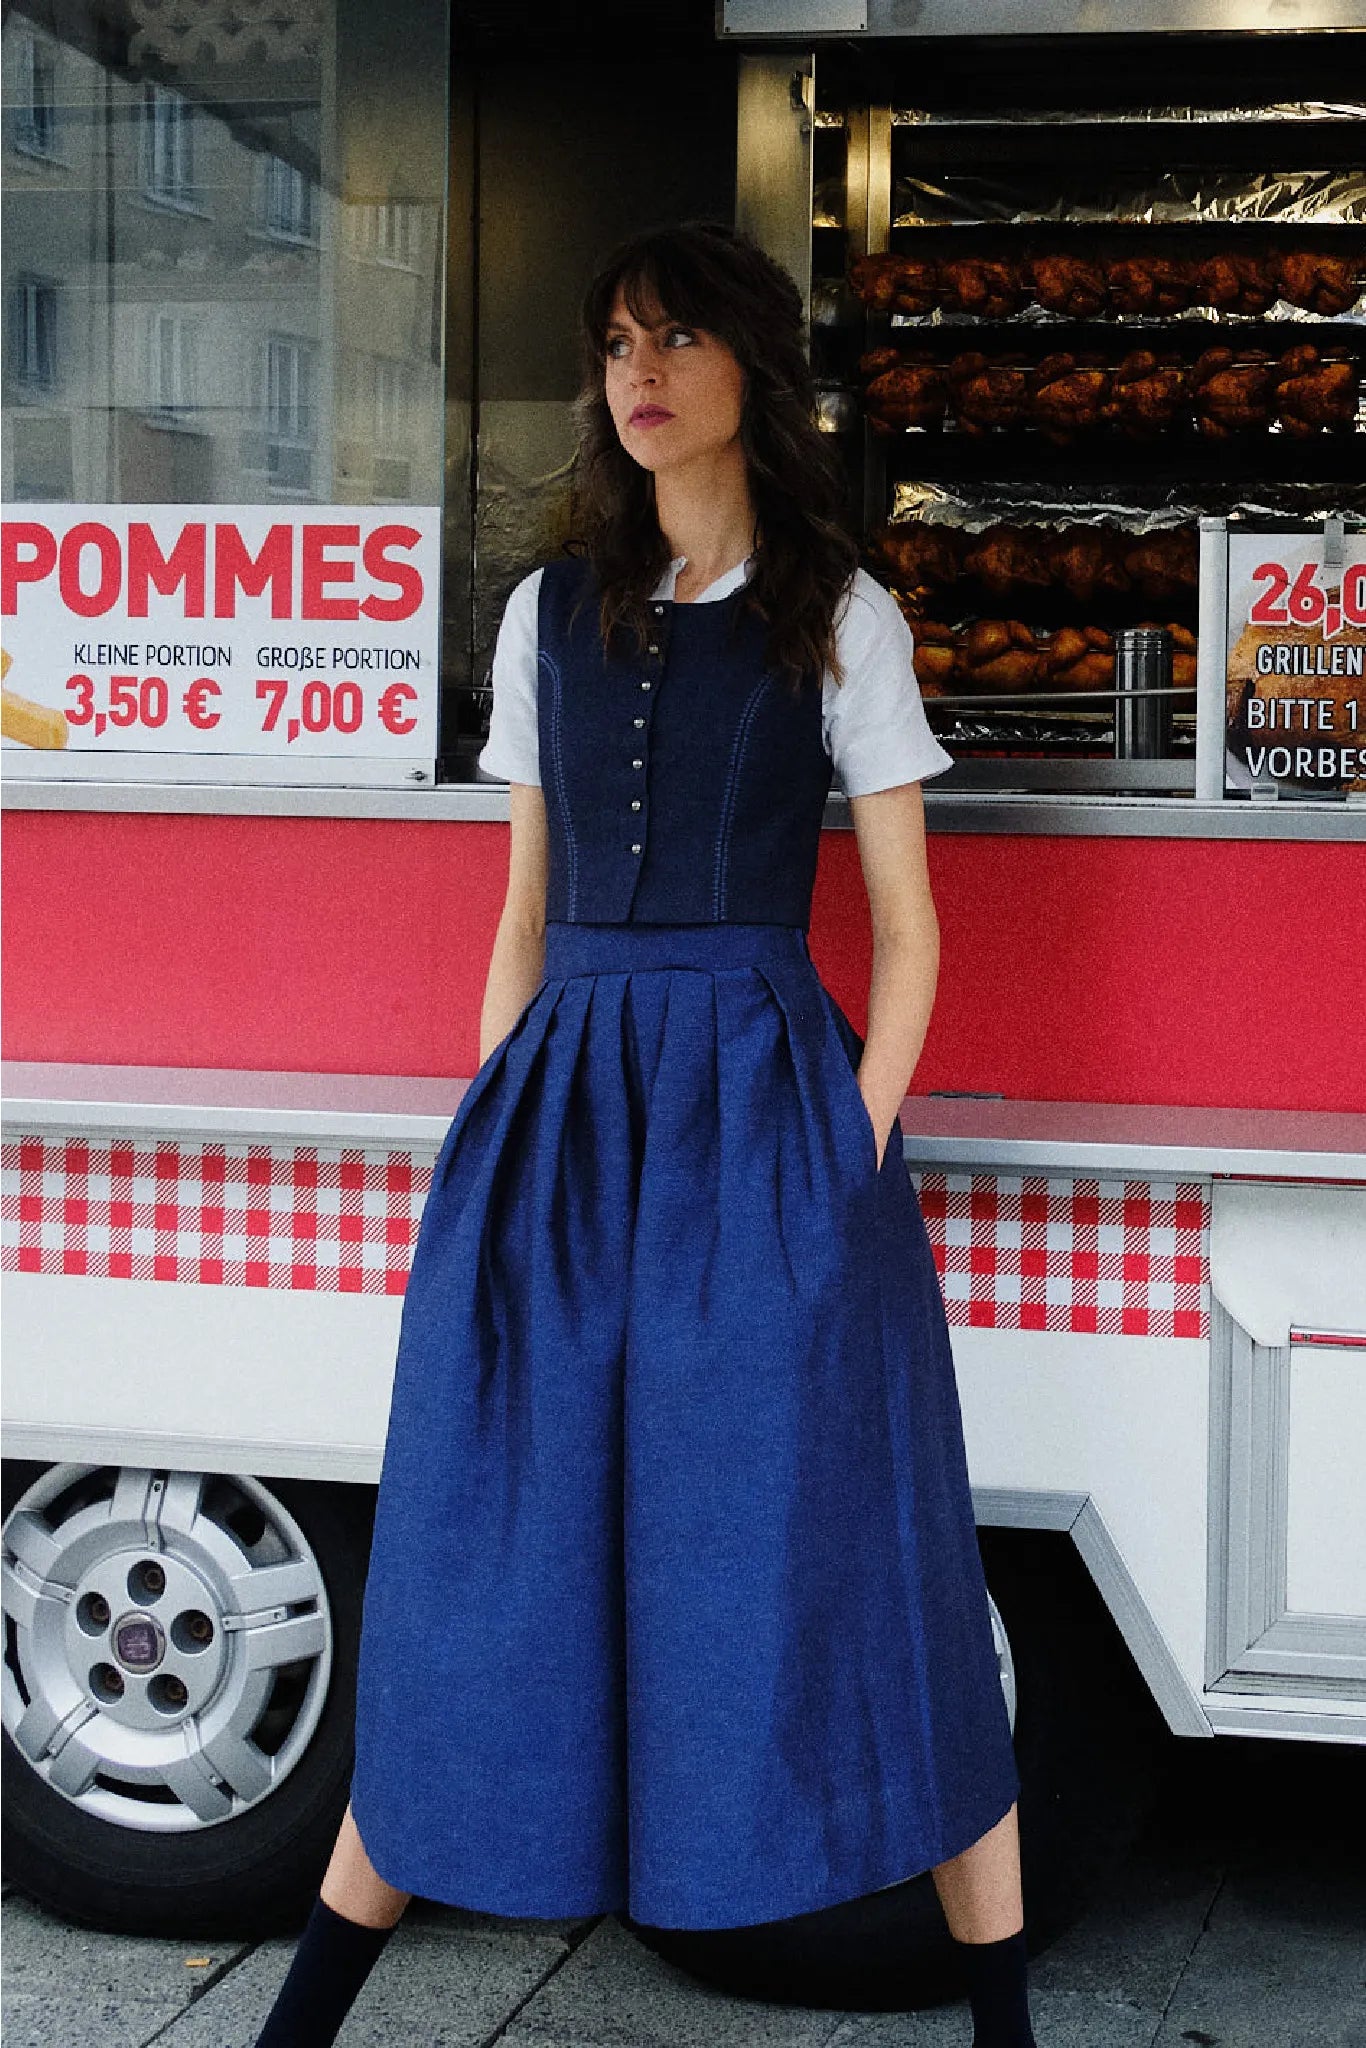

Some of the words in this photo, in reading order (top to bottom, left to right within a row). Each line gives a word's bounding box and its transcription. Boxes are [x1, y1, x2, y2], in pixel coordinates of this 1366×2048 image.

[1, 521, 424, 621] POMMES
[74, 645, 139, 666] KLEINE
[146, 646, 232, 667] PORTION
[332, 649, 420, 670] PORTION
[1257, 645, 1366, 675] GRILLEN
[65, 674, 169, 737] 3,50
[183, 677, 222, 730] €
[256, 680, 363, 744] 7,00
[378, 683, 418, 735] €
[1247, 698, 1334, 730] BITTE
[1345, 700, 1358, 731] 1
